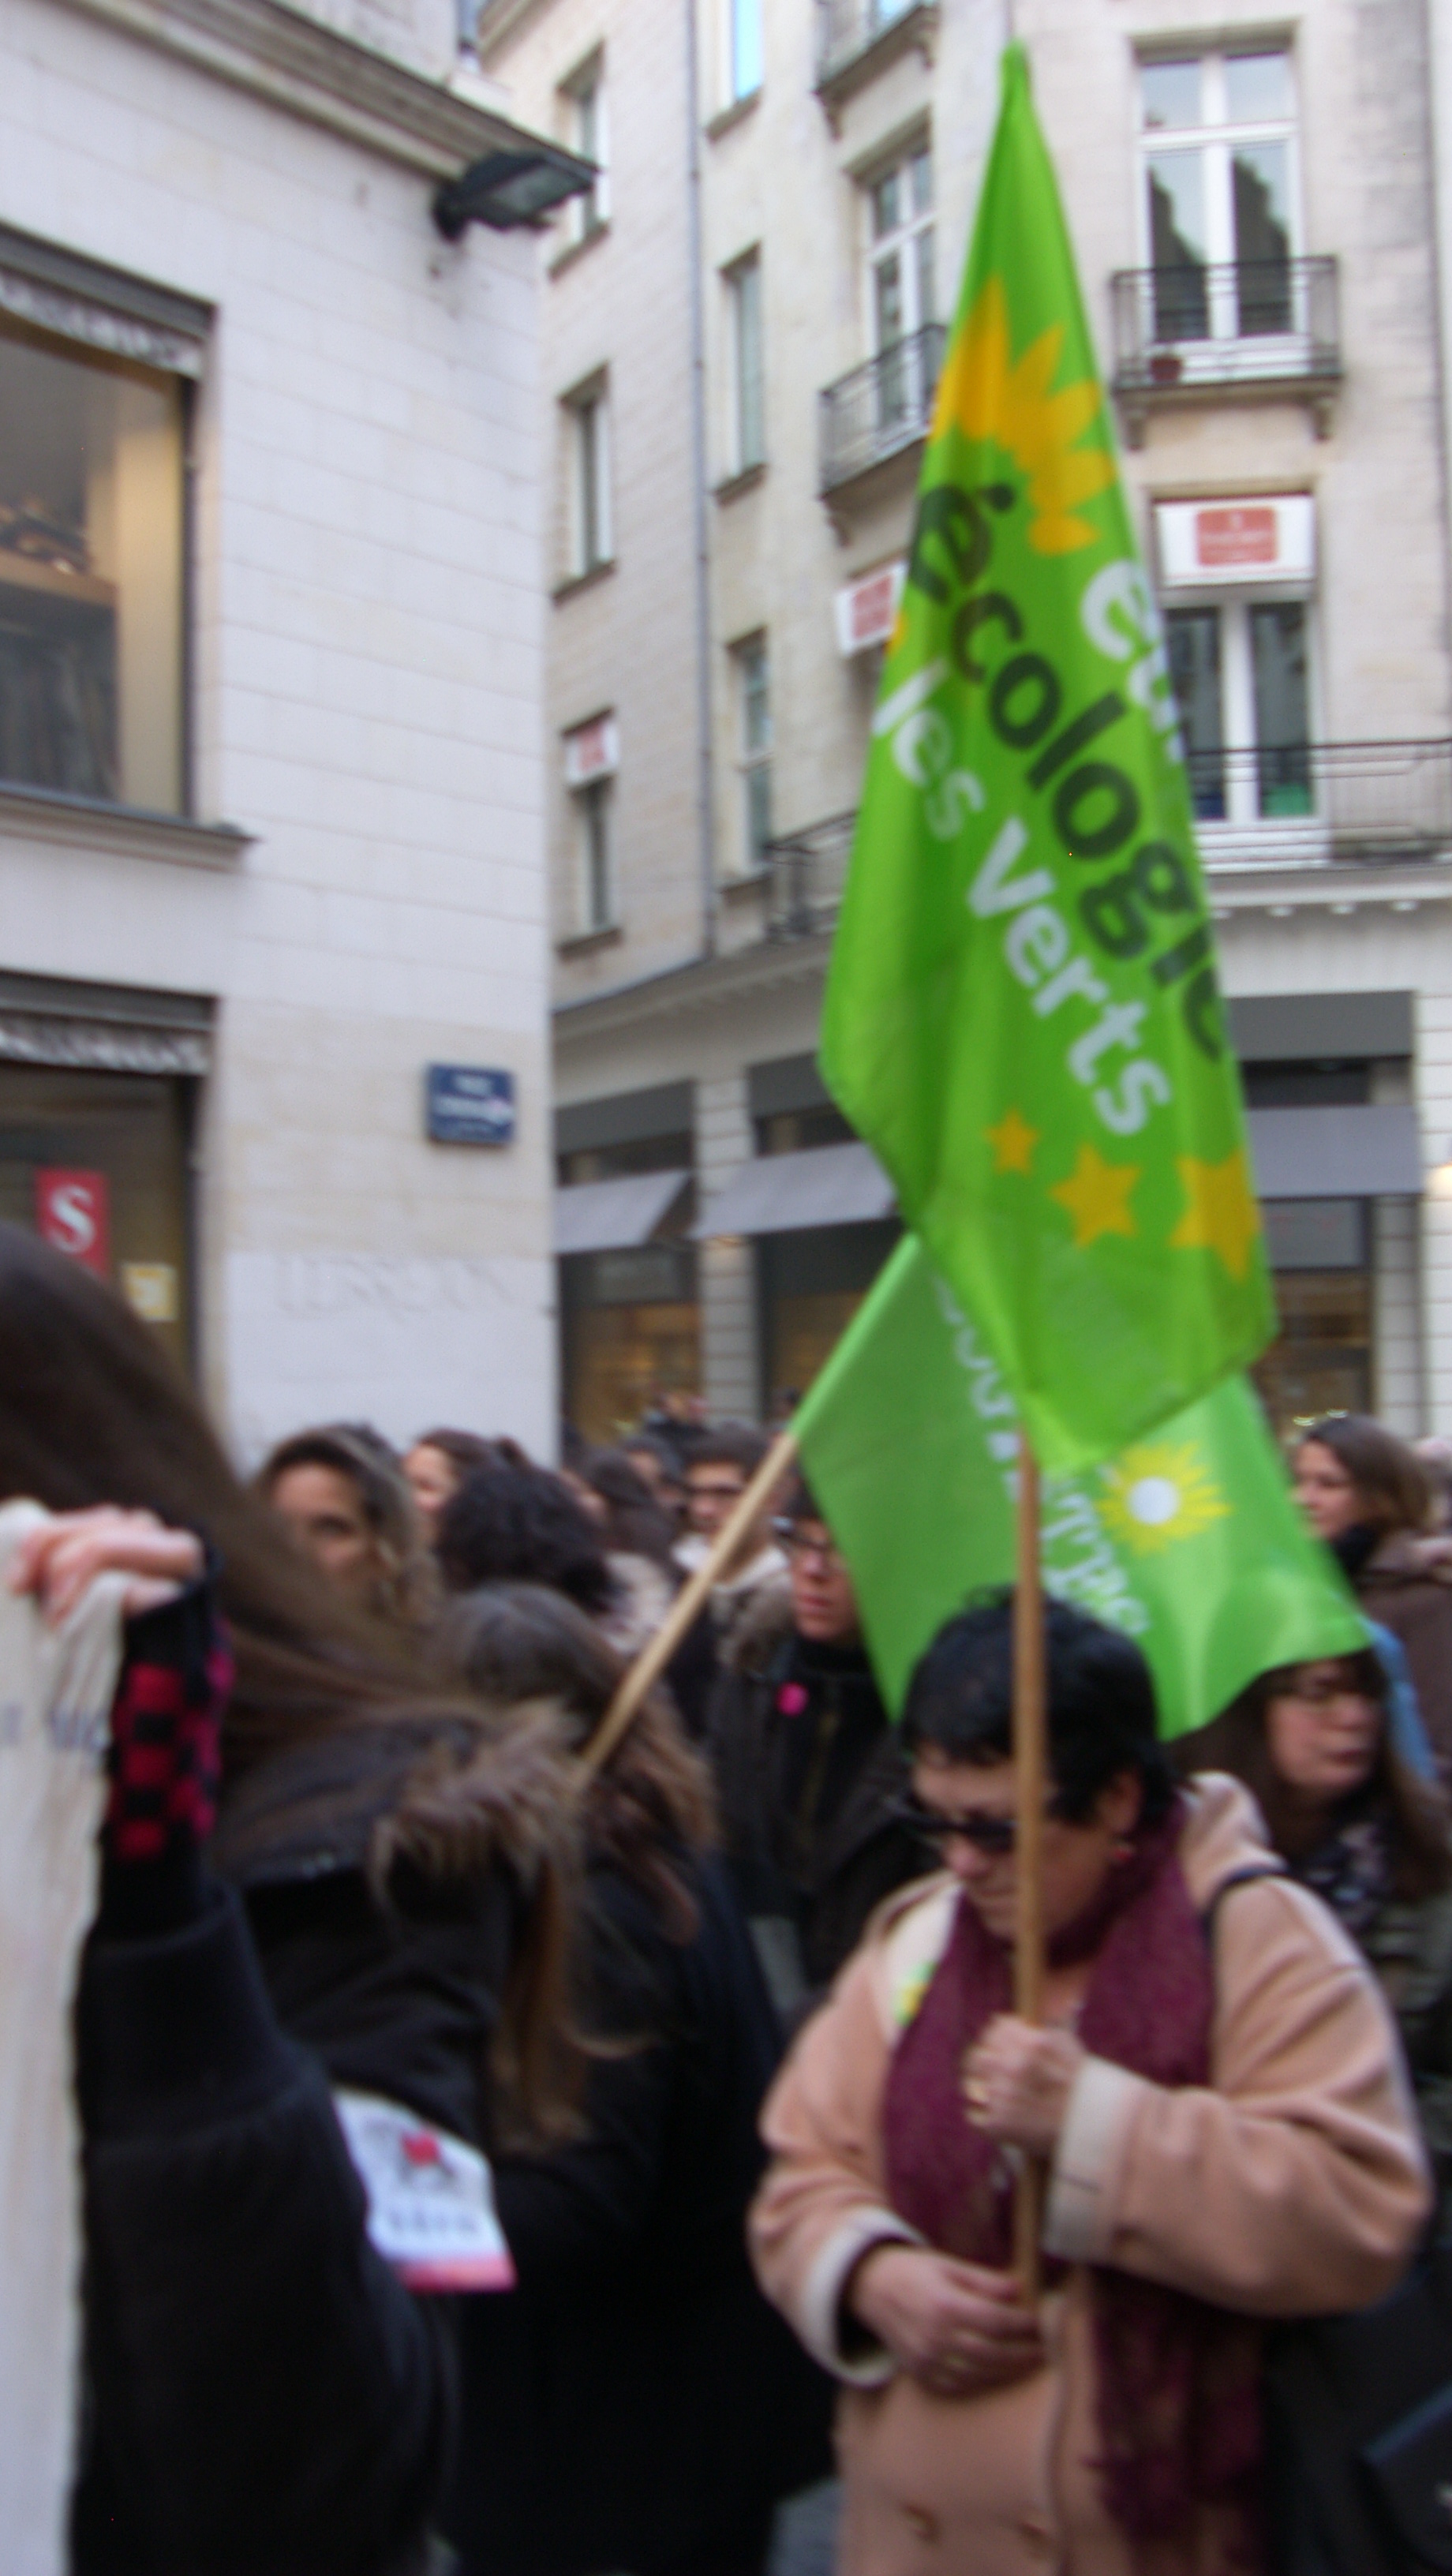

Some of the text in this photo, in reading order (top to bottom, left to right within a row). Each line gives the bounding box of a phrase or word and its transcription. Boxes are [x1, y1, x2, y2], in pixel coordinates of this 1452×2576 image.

[871, 657, 986, 840] les
[968, 815, 1172, 1136] Verts
[49, 1183, 95, 1254] S
